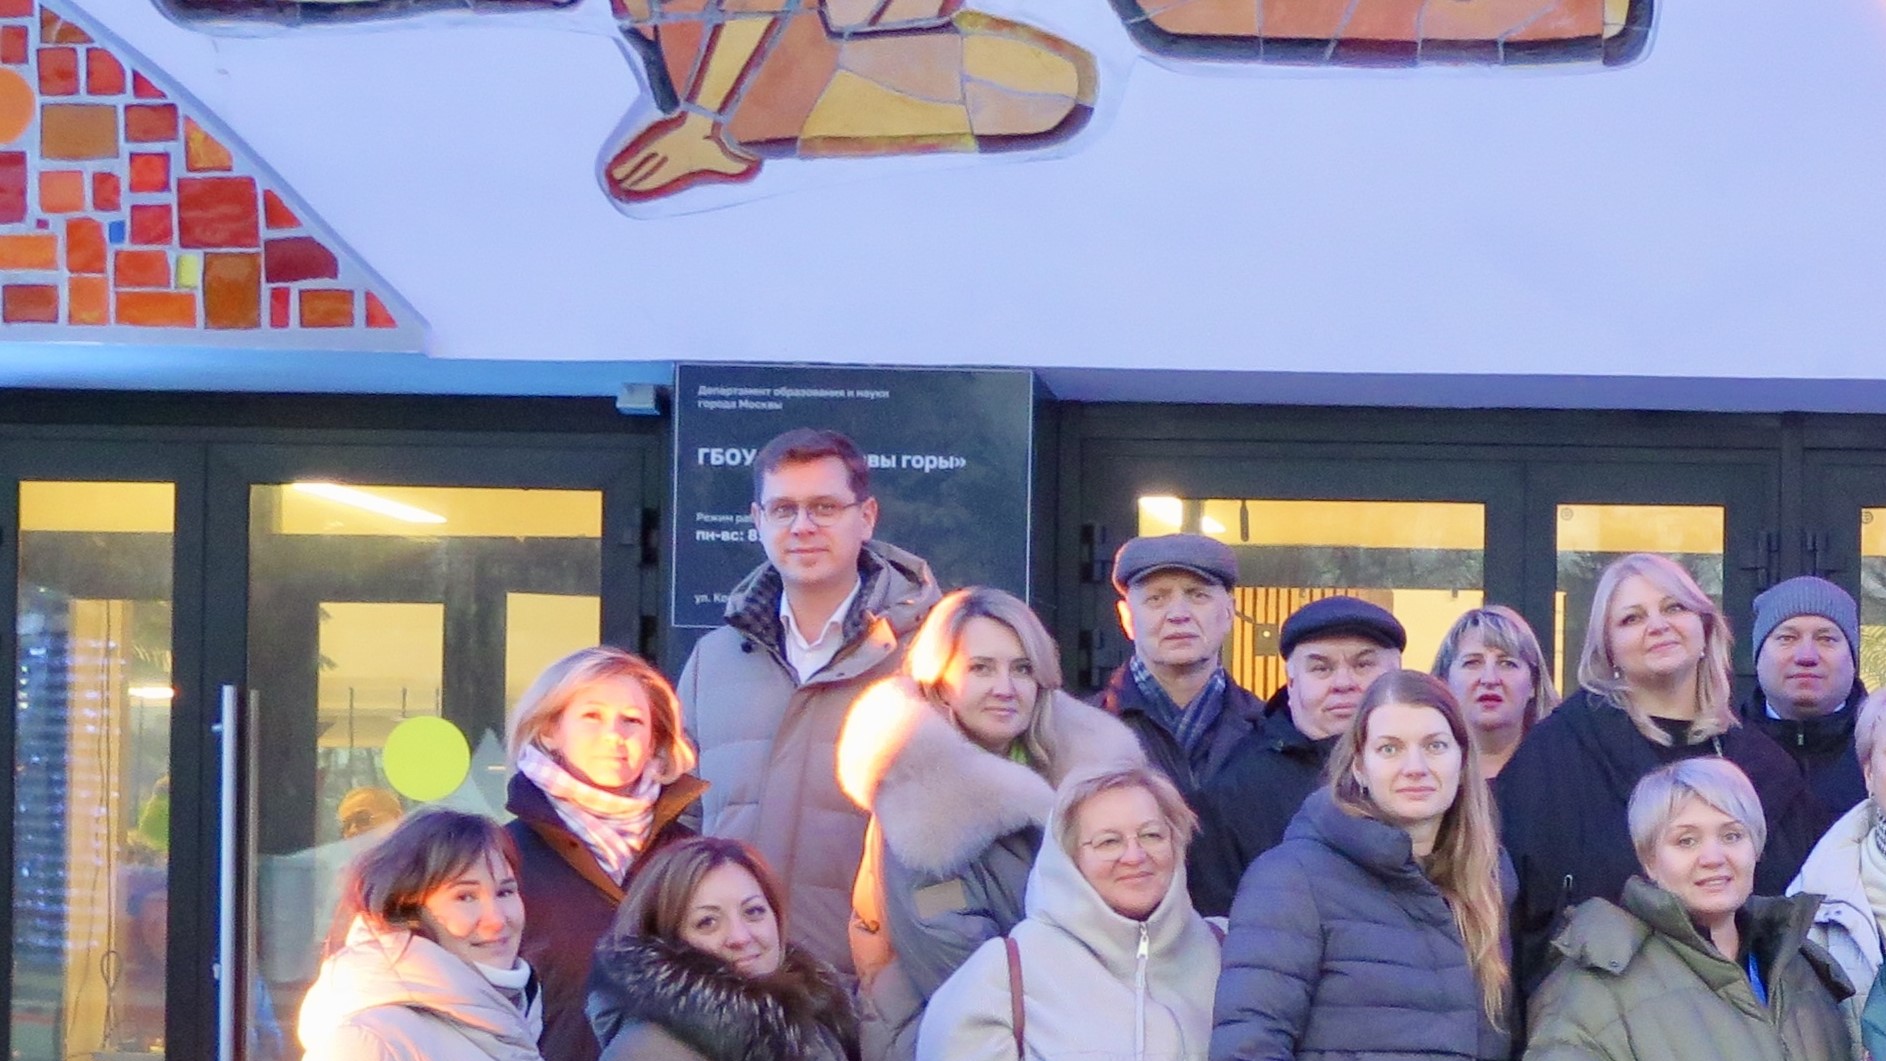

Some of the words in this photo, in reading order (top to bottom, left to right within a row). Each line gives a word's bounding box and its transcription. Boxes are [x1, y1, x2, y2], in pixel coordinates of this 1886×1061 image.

[697, 385, 771, 397] Департамент
[773, 386, 846, 399] образования
[847, 388, 855, 398] и
[856, 389, 890, 400] науки
[697, 399, 737, 411] города
[738, 399, 783, 410] Москвы
[697, 448, 758, 466] ГБОУ
[863, 453, 897, 469] вы
[901, 454, 967, 473] горы»
[696, 512, 734, 522] Режим
[695, 529, 744, 542] пн-вс:
